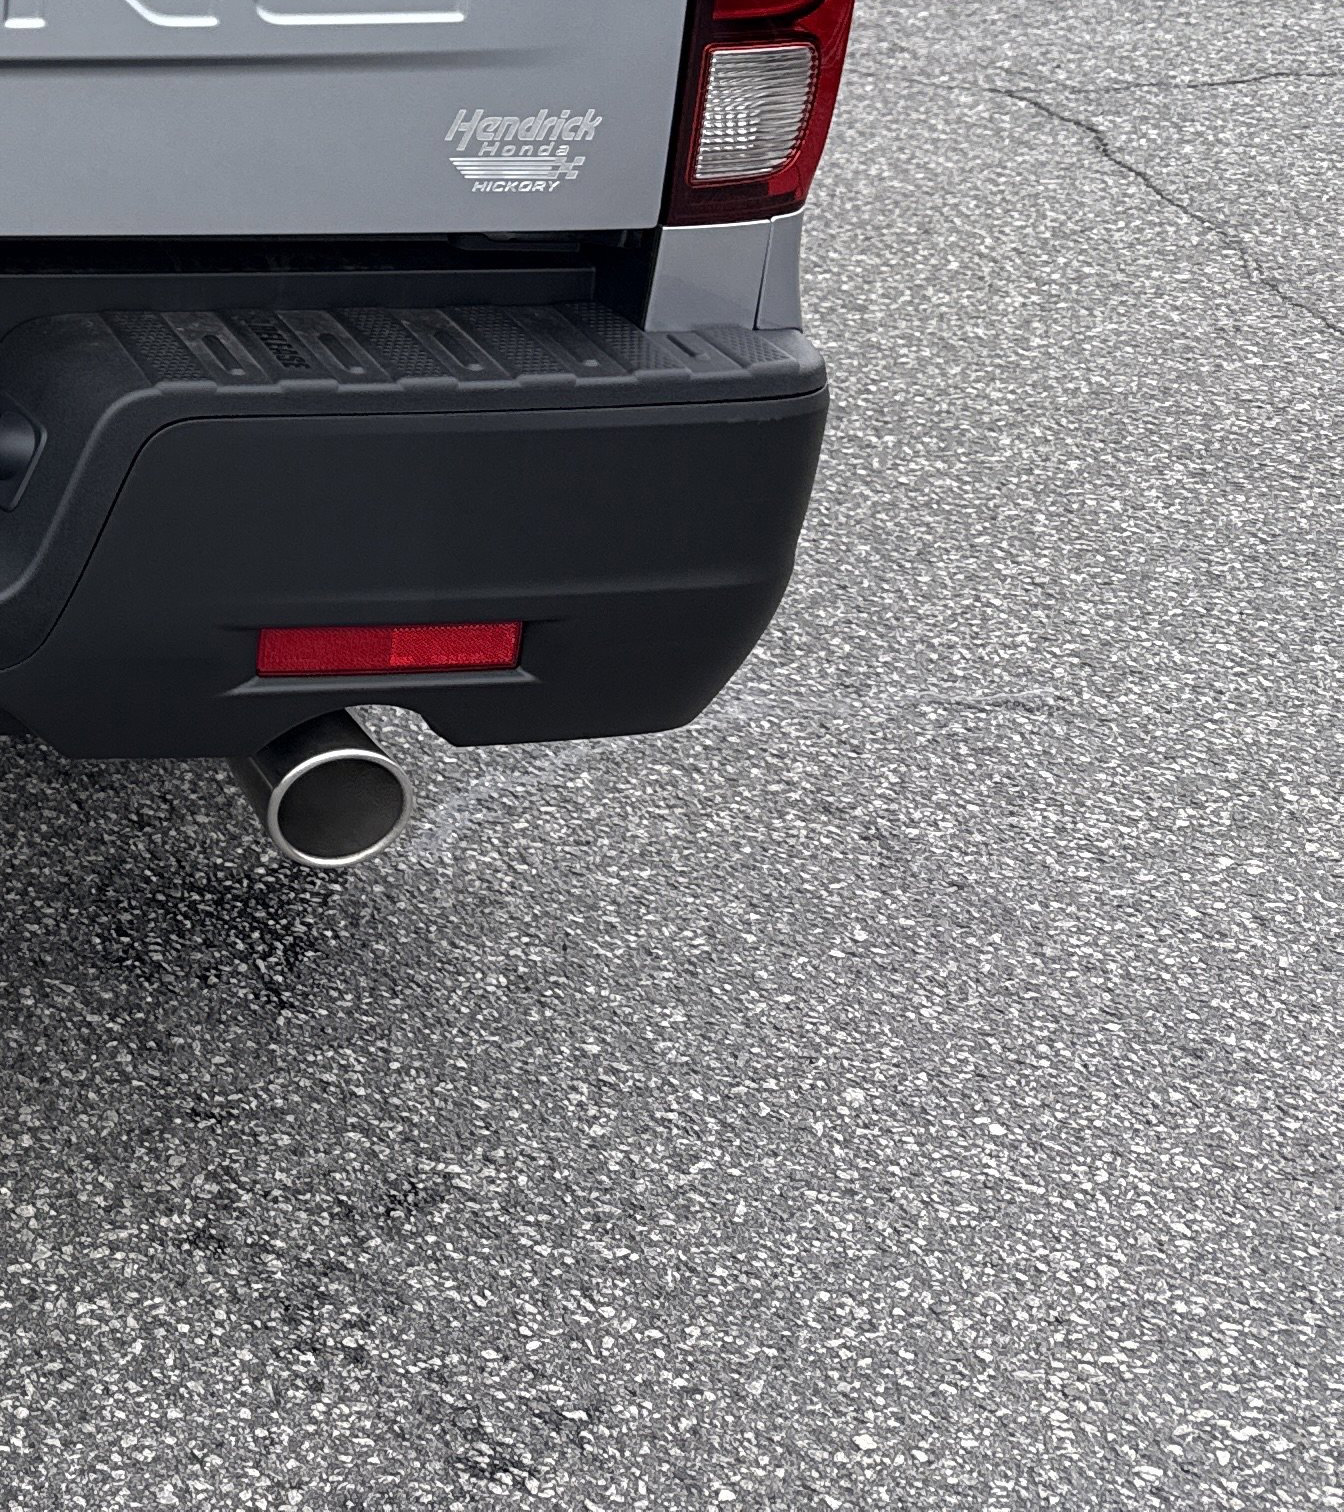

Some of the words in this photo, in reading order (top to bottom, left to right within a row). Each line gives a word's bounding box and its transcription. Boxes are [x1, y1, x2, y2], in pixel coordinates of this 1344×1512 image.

[444, 109, 603, 151] Hendrick
[478, 141, 570, 156] Honda
[471, 180, 560, 192] HICKORY
